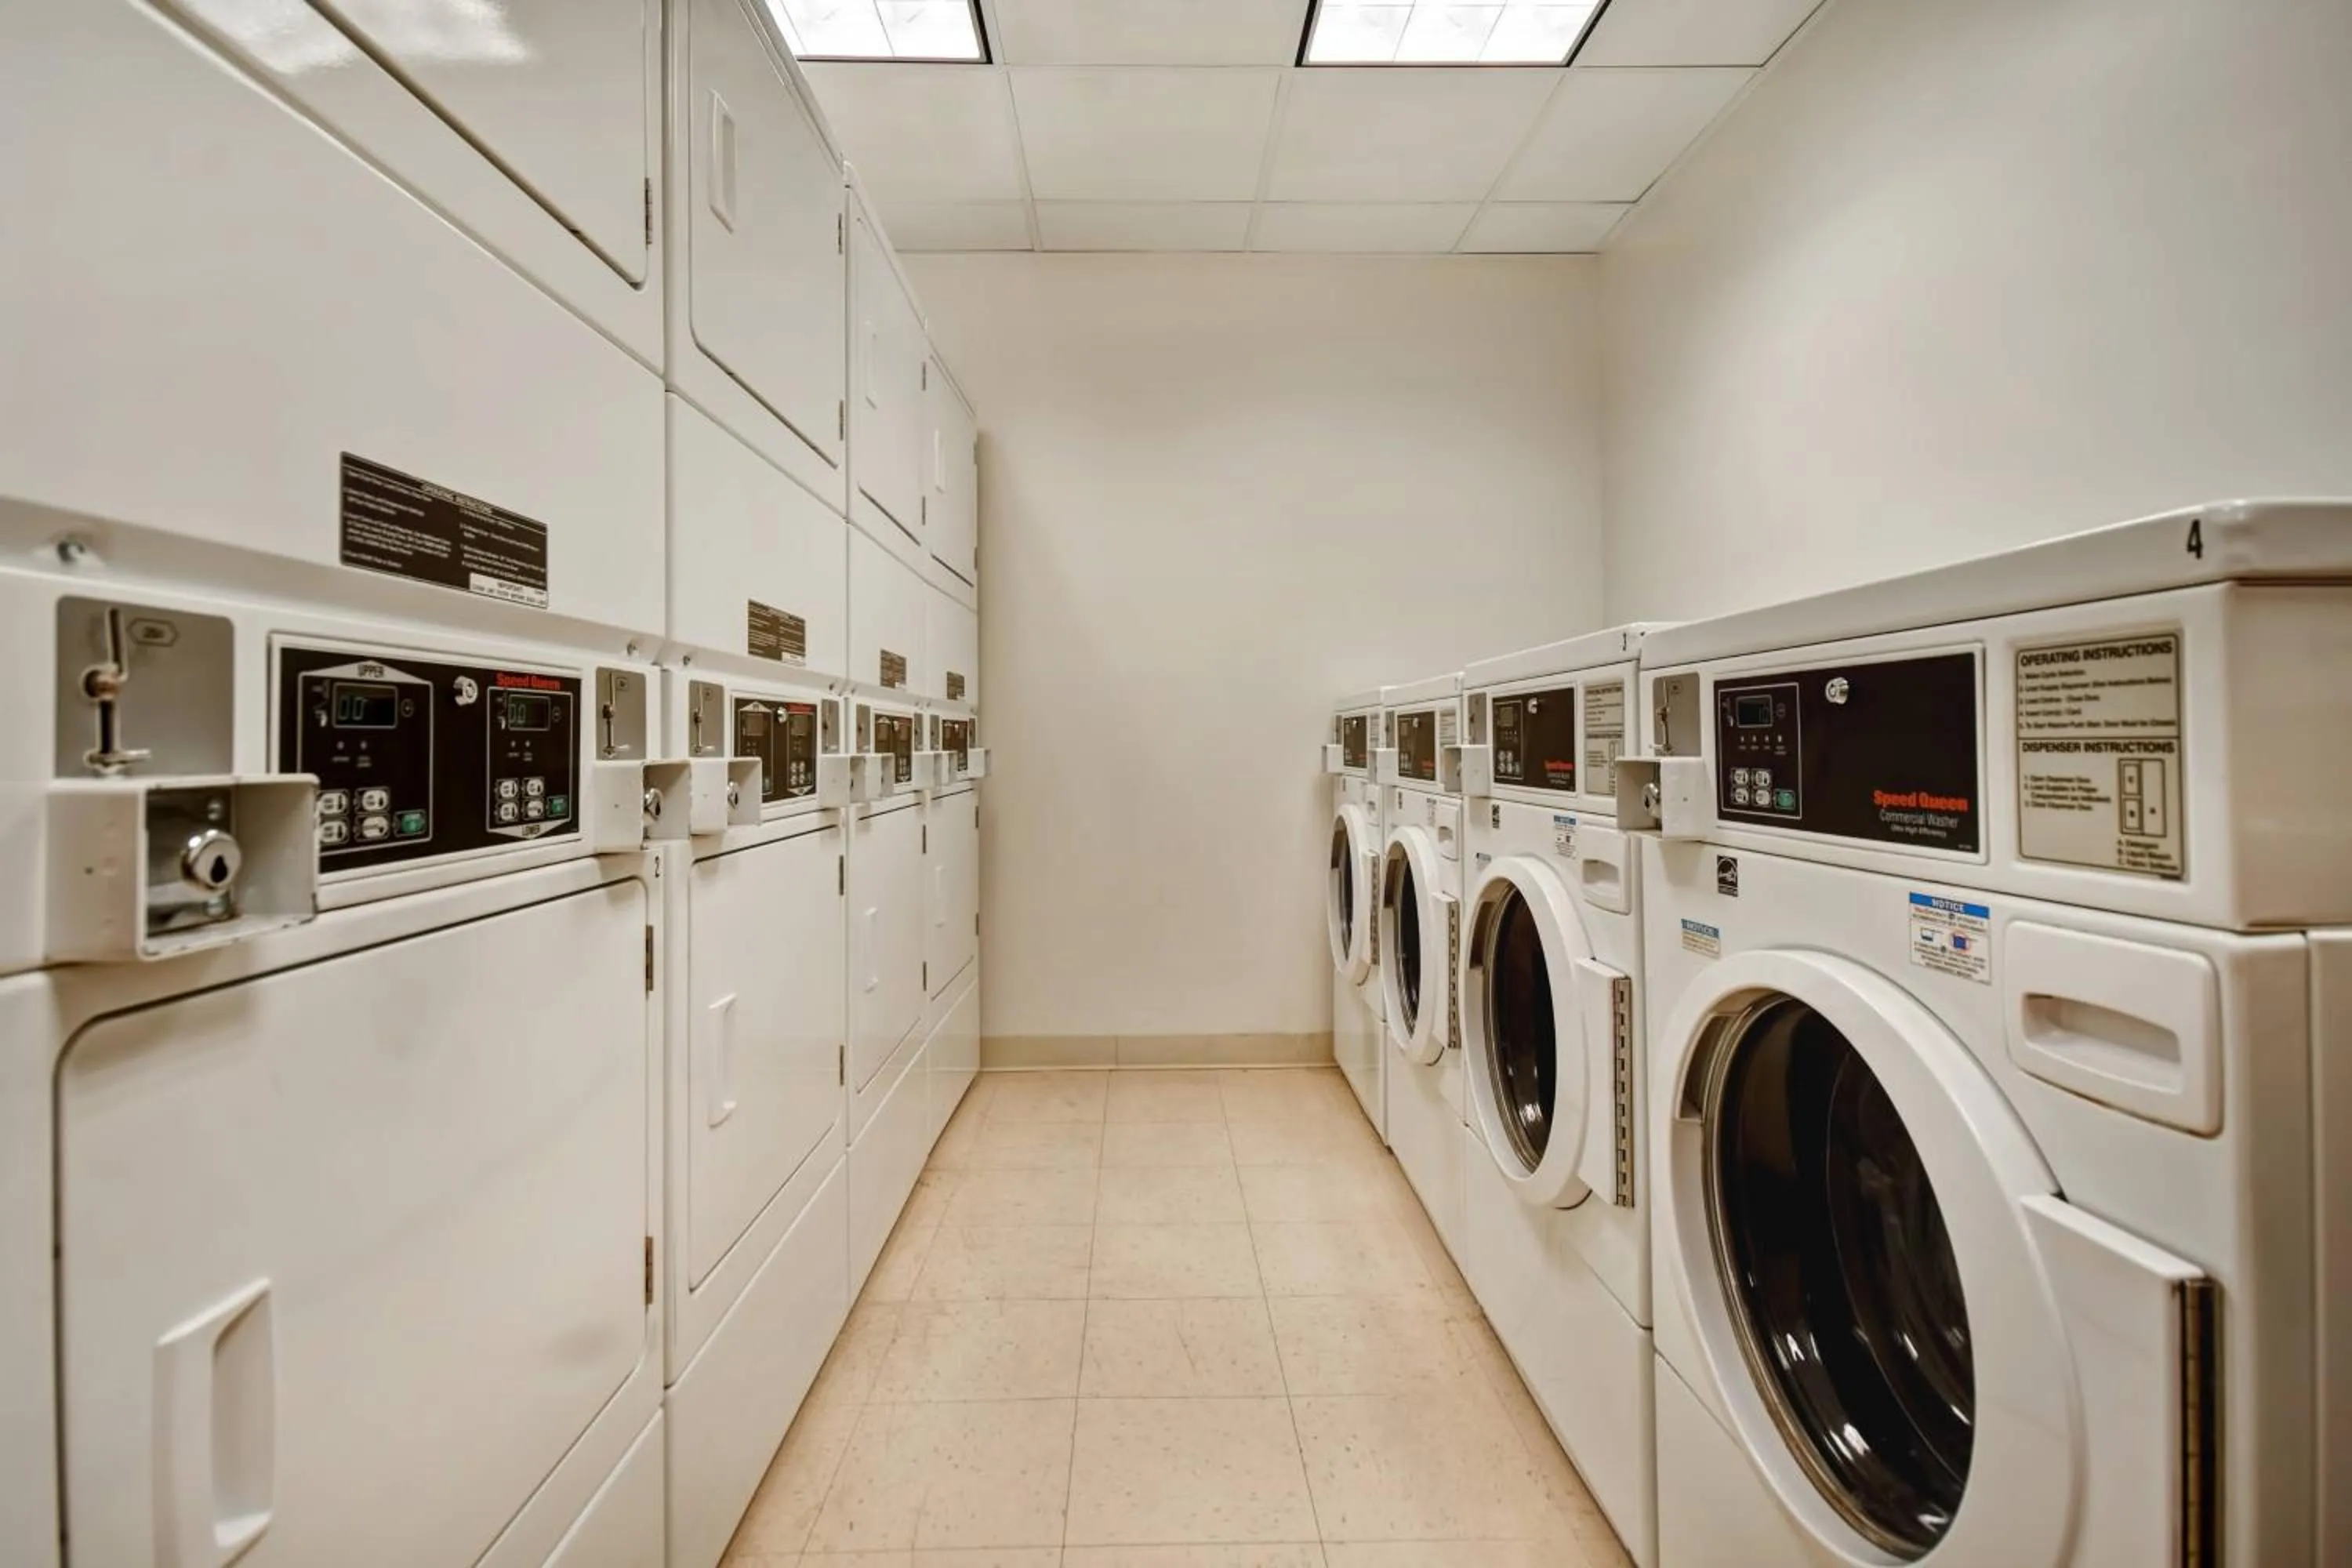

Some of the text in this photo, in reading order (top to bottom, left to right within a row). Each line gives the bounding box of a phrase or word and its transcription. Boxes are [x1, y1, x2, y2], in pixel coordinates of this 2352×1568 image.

[2187, 518, 2203, 560] 4
[2020, 641, 2172, 666] OPERATING INSTRUCTIONS
[358, 665, 385, 678] UPPER
[496, 673, 530, 690] Speed
[2022, 742, 2175, 754] DISPENSER INSTRUCTIONS
[1873, 789, 1969, 812] Speed Queen
[1880, 809, 1959, 829] Commercial Washer
[1931, 898, 1965, 913] NOTICE
